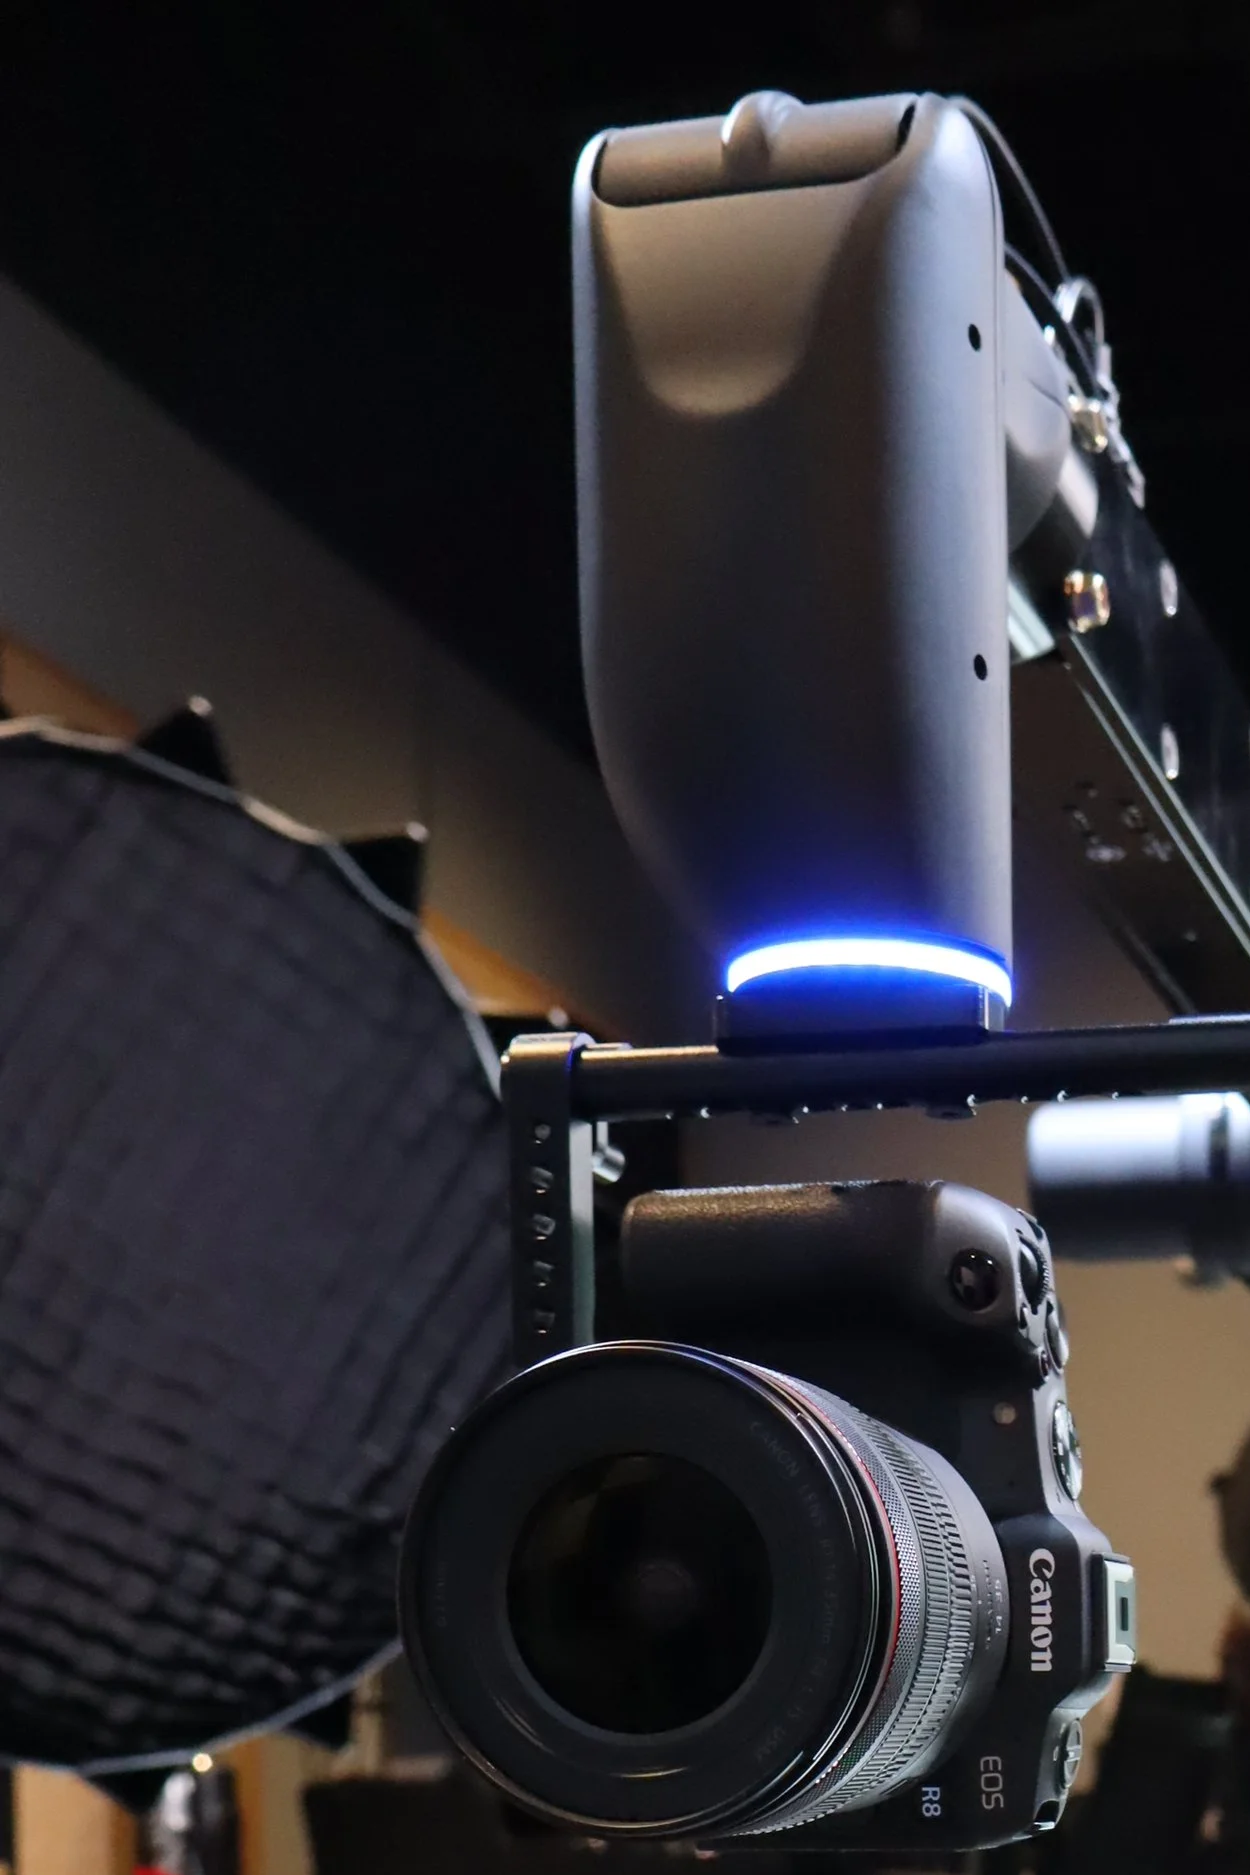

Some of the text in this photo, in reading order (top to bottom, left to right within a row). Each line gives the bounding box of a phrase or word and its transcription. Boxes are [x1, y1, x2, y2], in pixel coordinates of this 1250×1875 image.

[750, 1421, 800, 1478] CANON
[1029, 1548, 1055, 1672] Canon
[921, 1786, 941, 1817] R8
[980, 1756, 1004, 1810] EOS
